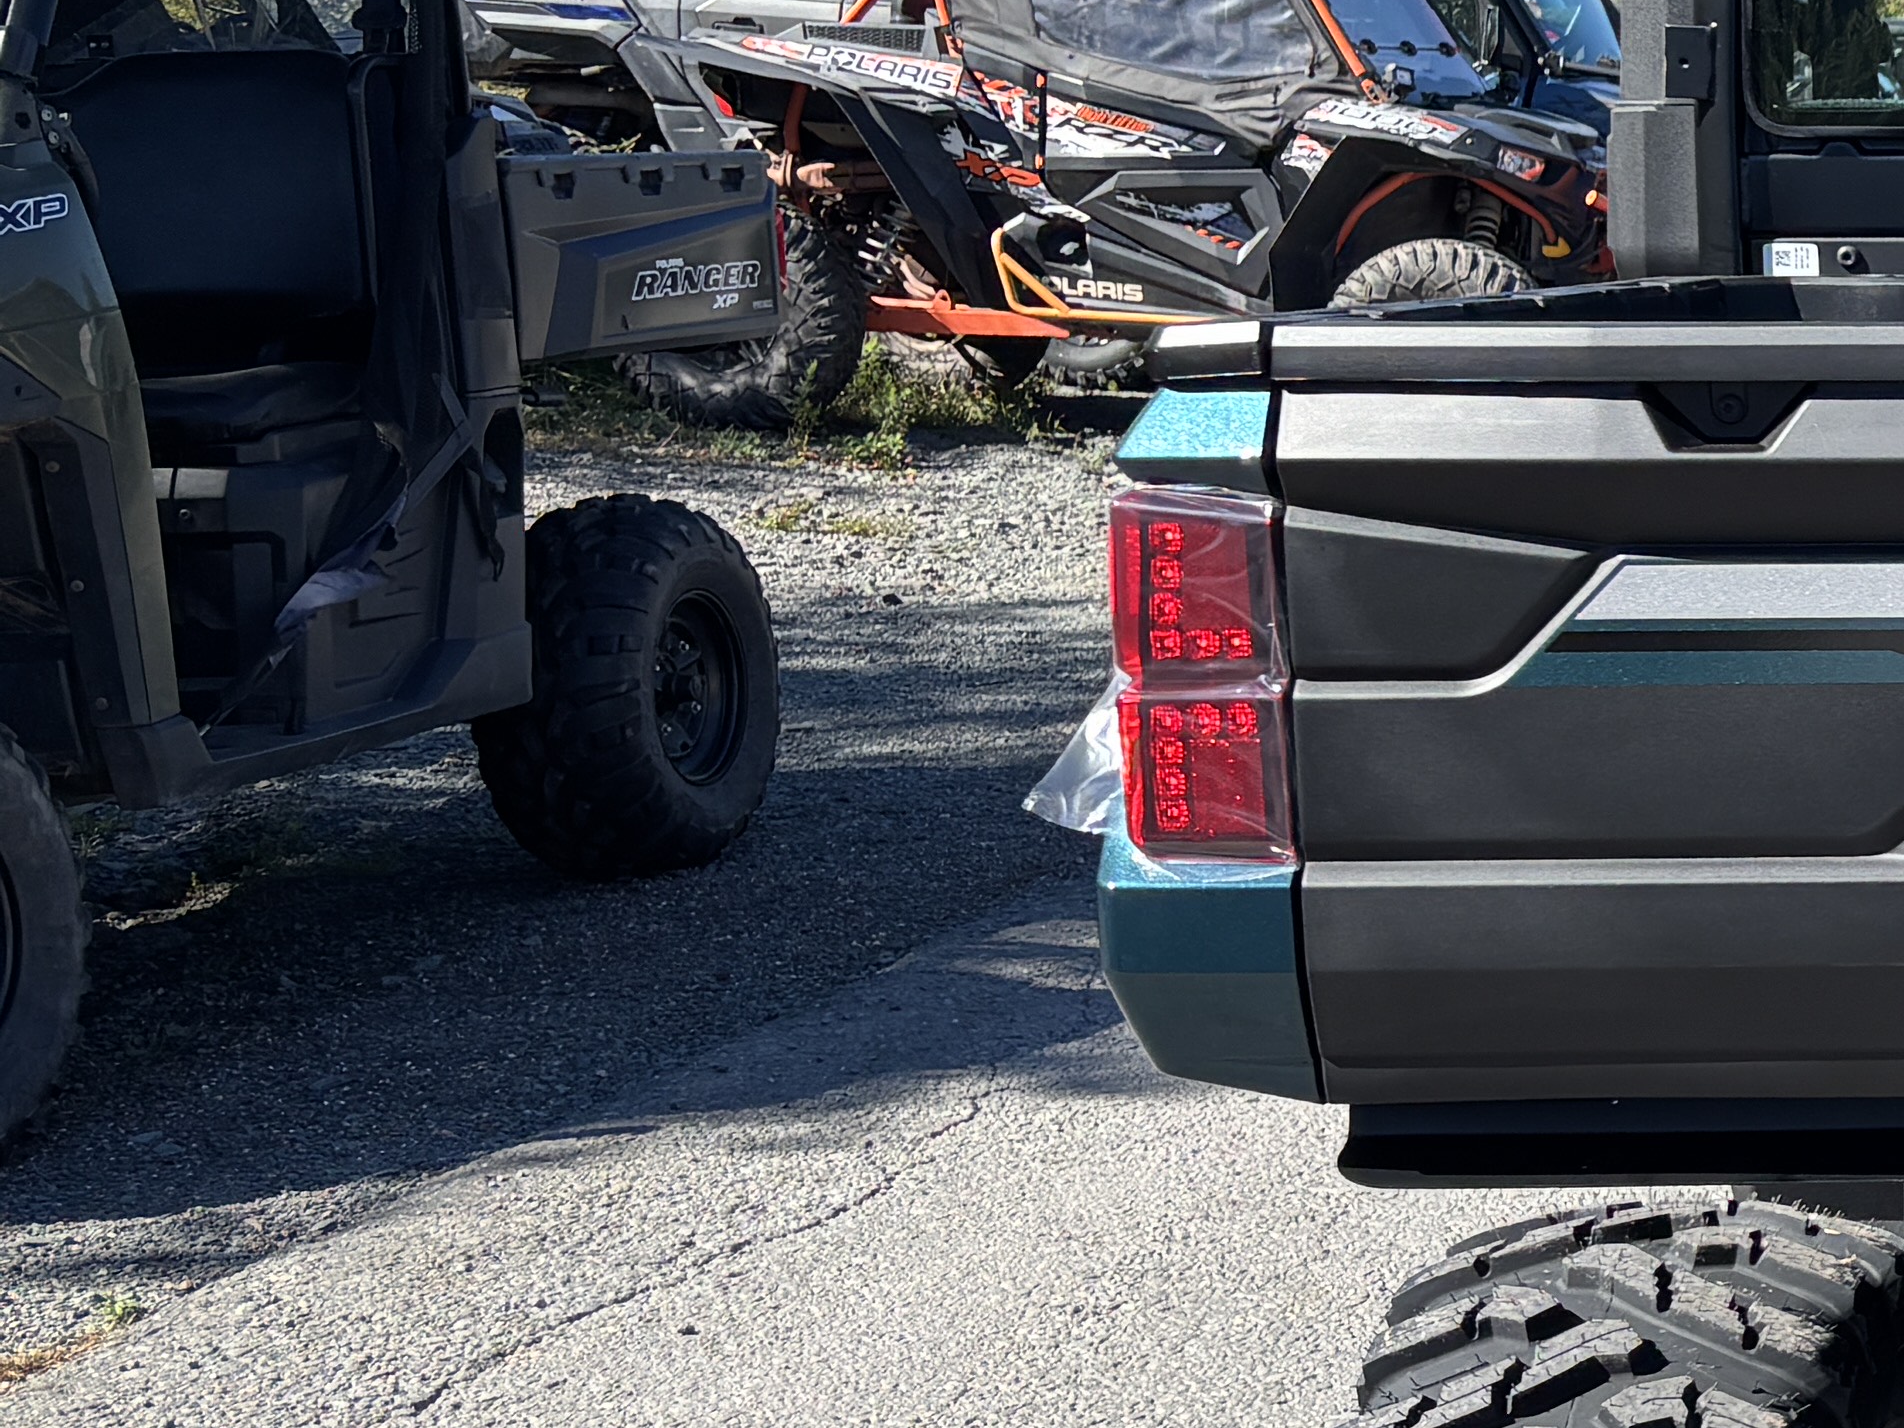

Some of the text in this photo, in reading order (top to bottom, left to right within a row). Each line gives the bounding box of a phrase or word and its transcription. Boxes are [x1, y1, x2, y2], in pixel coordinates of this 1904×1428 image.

[807, 45, 953, 90] POLARIS
[0, 193, 68, 235] XP
[632, 260, 761, 301] RANGER
[1022, 275, 1143, 302] OLARIS
[713, 293, 739, 310] XP
